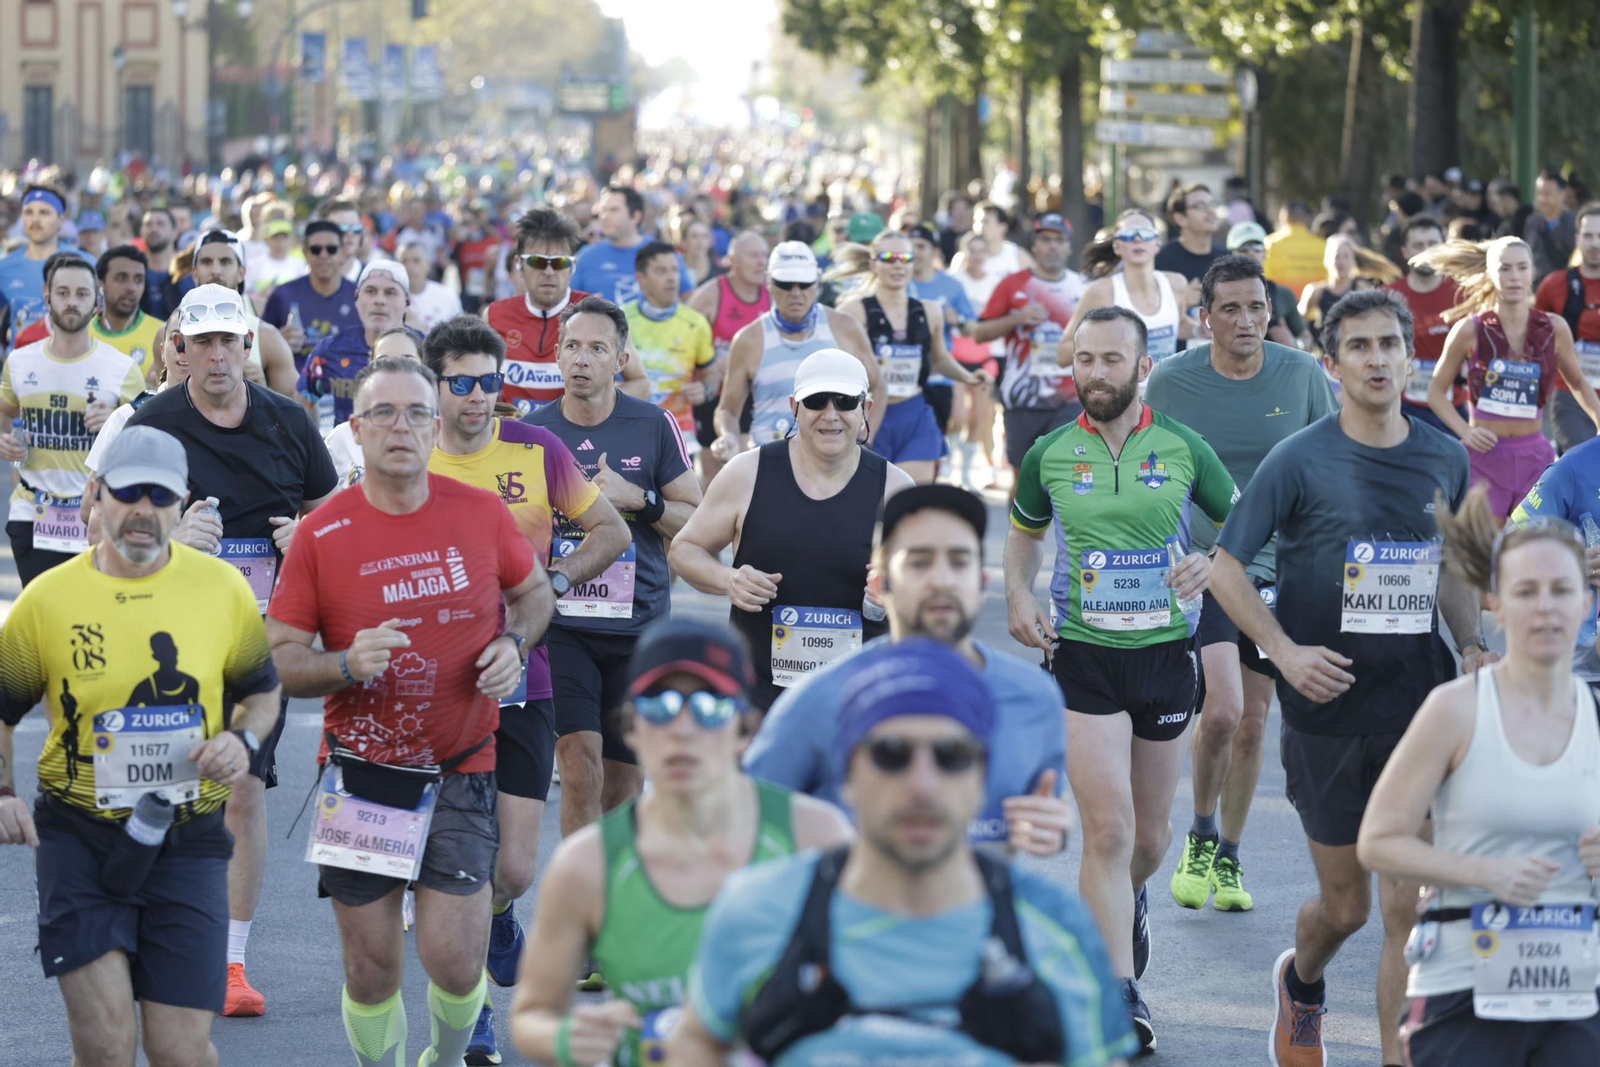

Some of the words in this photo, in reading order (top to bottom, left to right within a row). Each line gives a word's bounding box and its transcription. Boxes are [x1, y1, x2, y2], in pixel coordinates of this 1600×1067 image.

[49, 394, 68, 409] 59
[37, 435, 95, 451] SEBASTI
[34, 521, 80, 538] ALVARO
[227, 543, 269, 554] ZURICH
[1380, 547, 1430, 560] ZURICH
[377, 550, 441, 571] GENERALI
[1112, 553, 1161, 566] ZURICH
[1114, 578, 1140, 590] 5238
[1378, 575, 1411, 587] 10606
[383, 576, 451, 604] MÁLAGA
[1082, 600, 1146, 612] ALEJANDRO
[1149, 598, 1170, 611] ANA
[1344, 593, 1382, 610] KAKI
[1388, 594, 1434, 611] LOREN
[804, 612, 852, 625] ZURICH
[801, 636, 834, 649] 10995
[772, 657, 817, 671] DOMINGO
[131, 711, 190, 728] ZURICH
[130, 743, 170, 757] 11677
[127, 762, 173, 783] DOM
[356, 809, 387, 826] 9213
[318, 827, 352, 845] JOSE
[354, 833, 415, 857] ALMERÍA
[1517, 906, 1582, 927] ZURICH
[1518, 942, 1563, 958] 12424
[1508, 965, 1571, 990] ANNA
